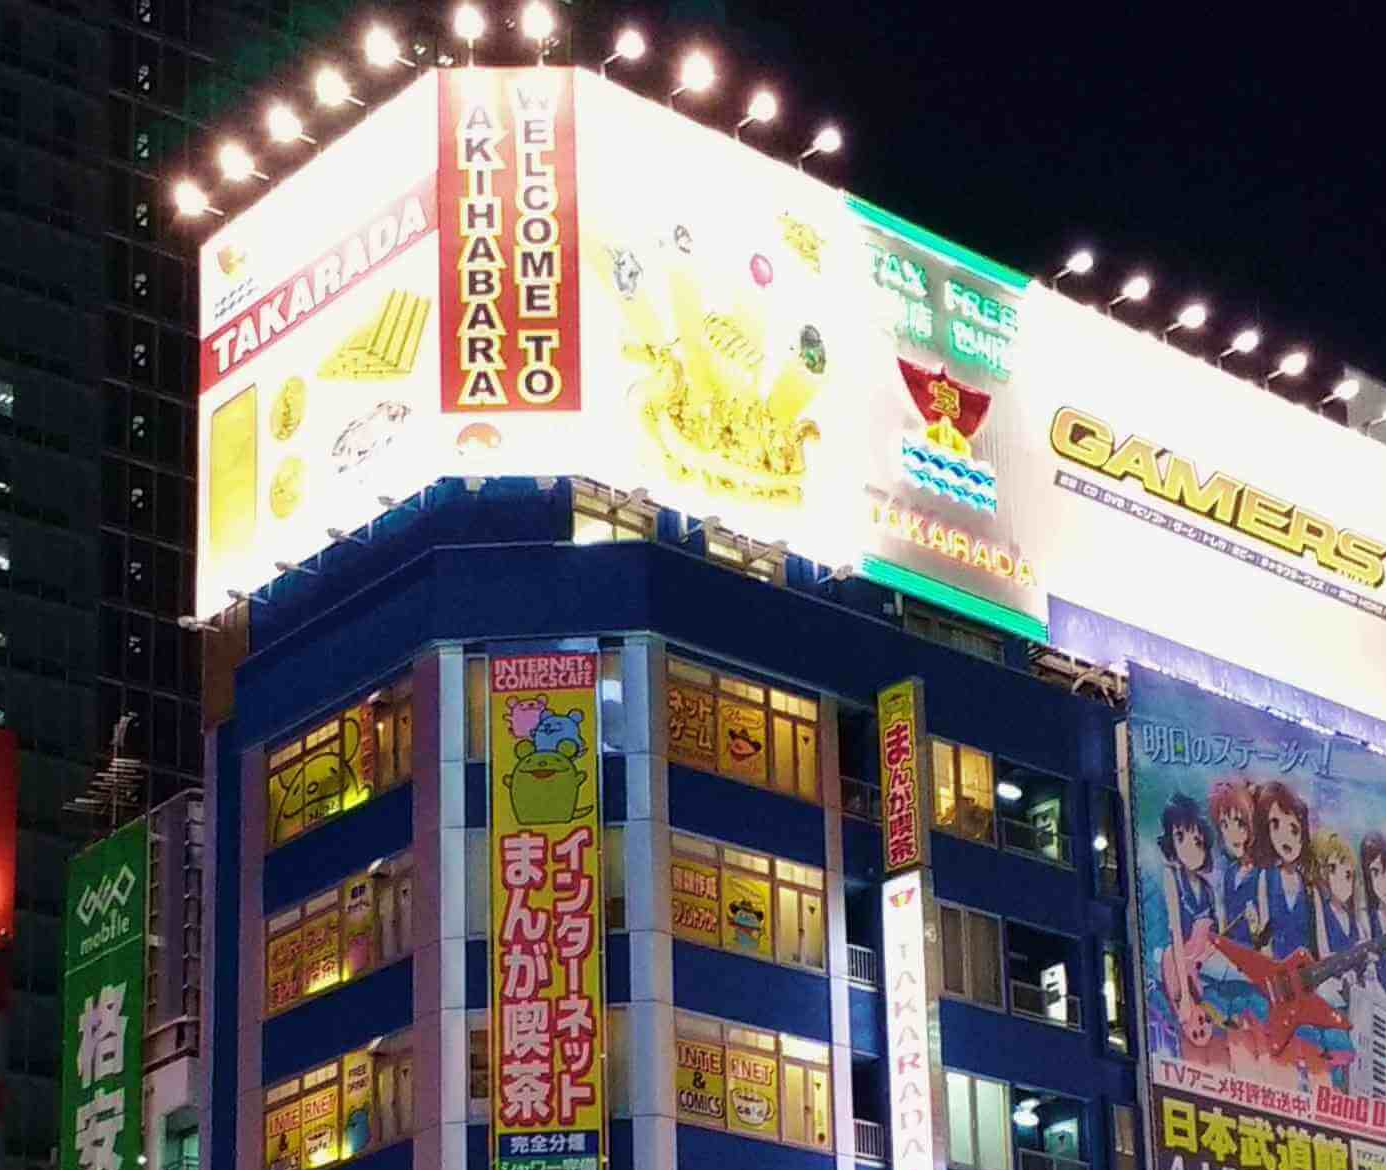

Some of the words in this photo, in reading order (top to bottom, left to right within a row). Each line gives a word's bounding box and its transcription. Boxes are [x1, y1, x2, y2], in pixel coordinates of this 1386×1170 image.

[464, 105, 499, 399] AKIHABARA
[516, 87, 555, 313] WELCOME
[213, 196, 429, 374] TAKARADA
[521, 334, 555, 397] TO
[870, 500, 1038, 588] TAKARADA
[883, 723, 917, 867] まんが喫茶
[79, 911, 130, 957] mobile
[500, 832, 552, 1128] まんが喫茶
[553, 827, 594, 1126] インターネット
[510, 1131, 587, 1153] 完全分煙
